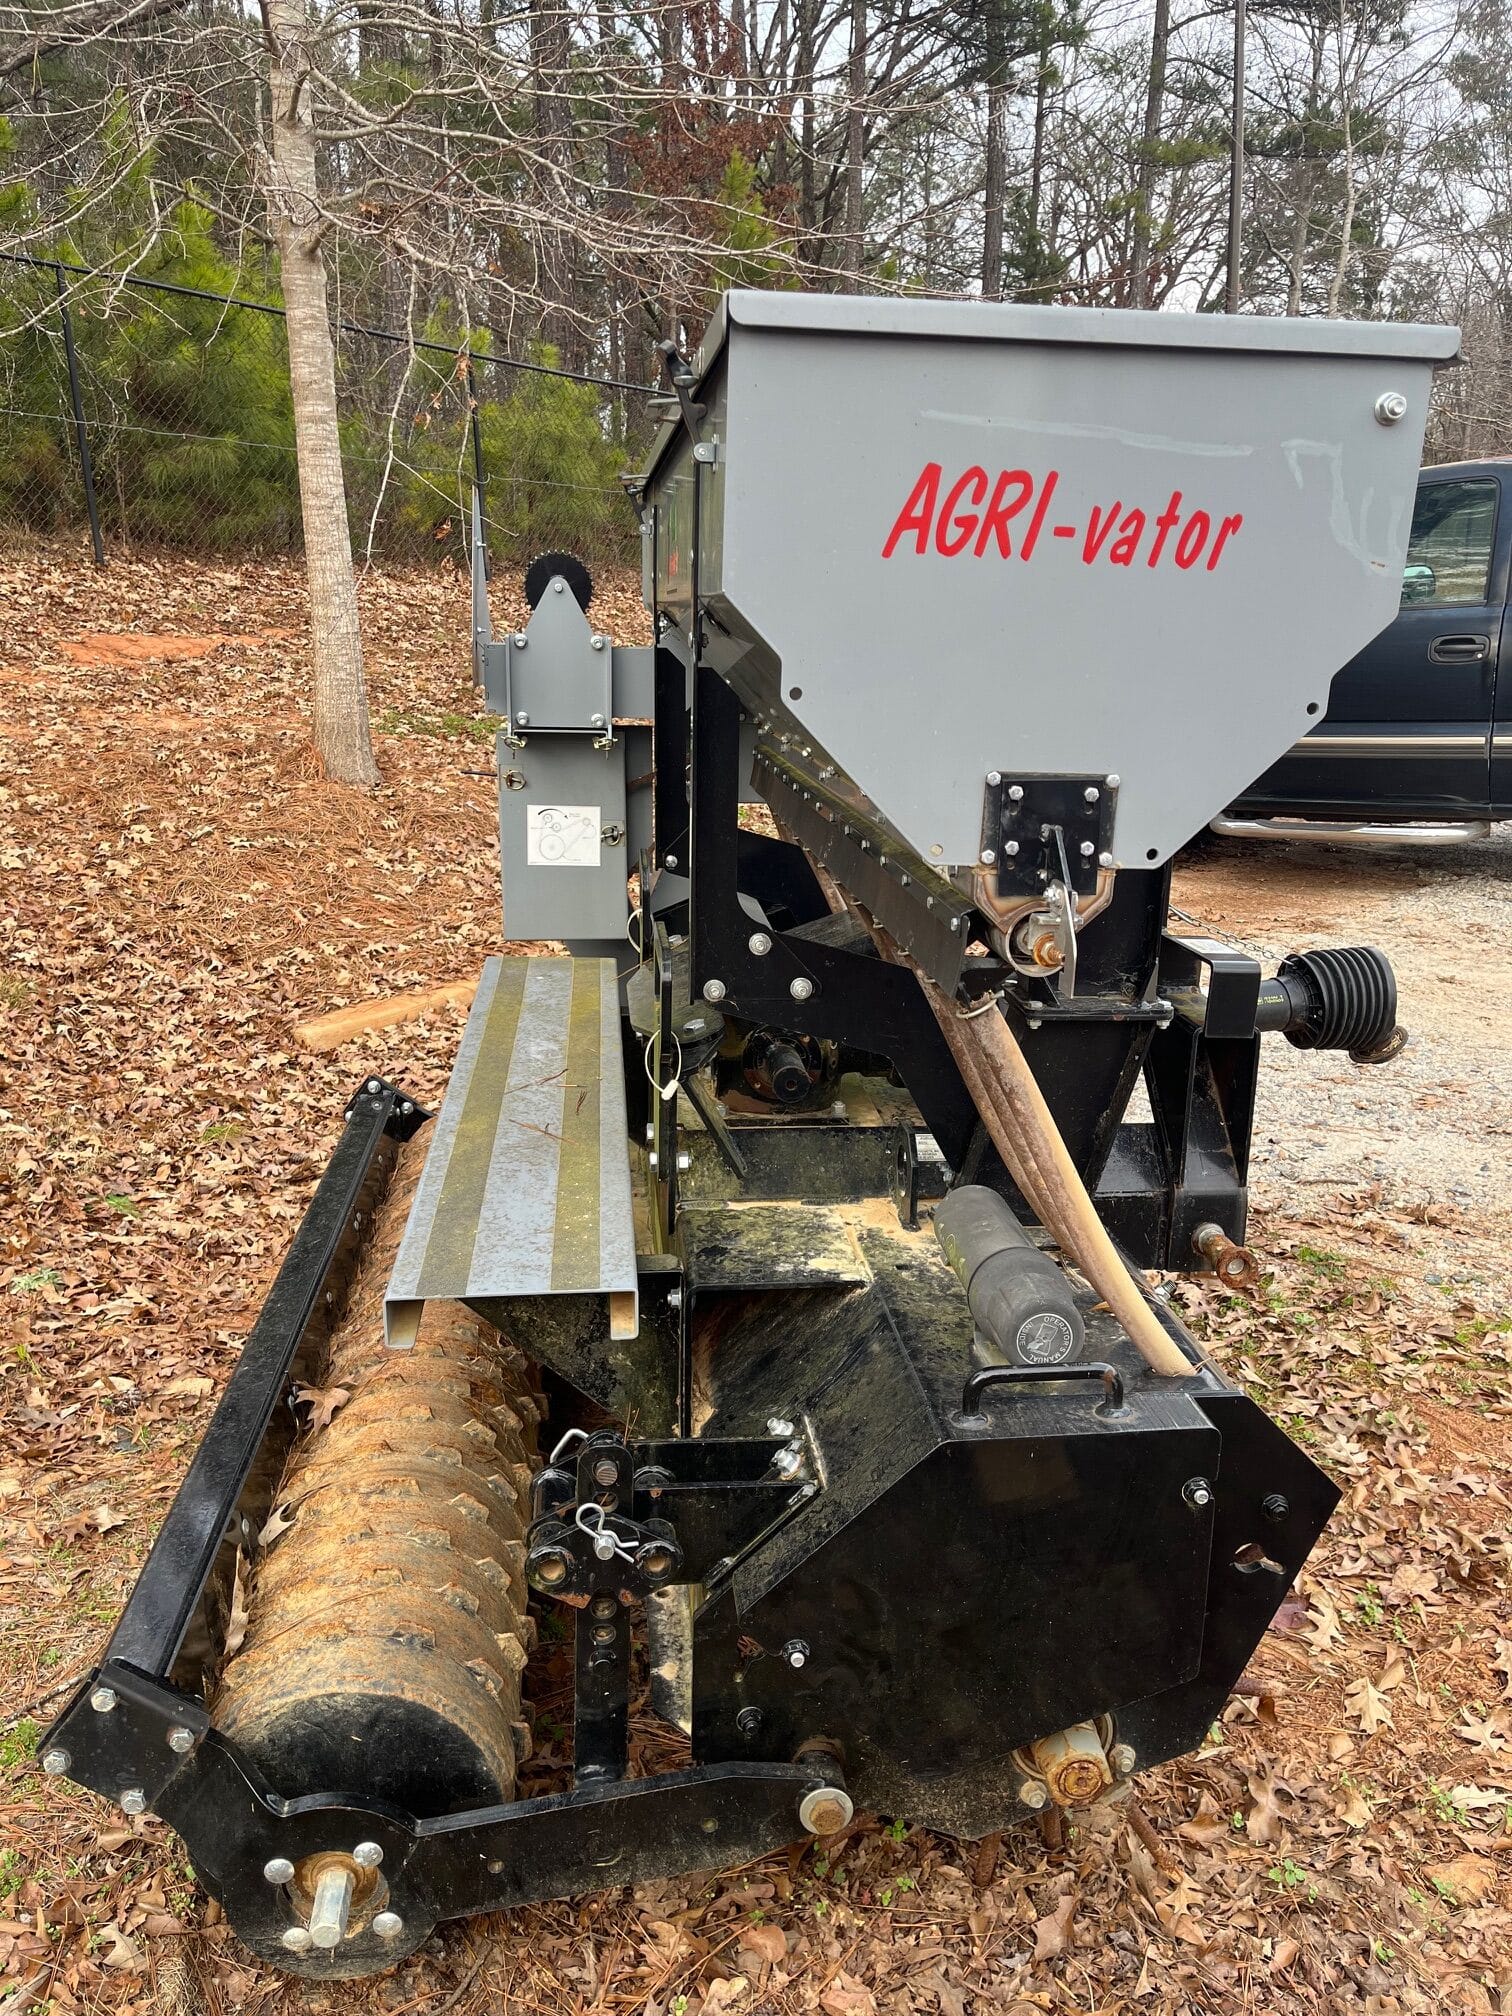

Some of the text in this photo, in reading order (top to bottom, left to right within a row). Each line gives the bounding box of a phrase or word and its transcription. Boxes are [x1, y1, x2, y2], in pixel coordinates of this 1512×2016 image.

[881, 462, 1243, 571] AGRI-vator
[1019, 1316, 1070, 1364] OPERATOR'S MANUAL INSIDE
